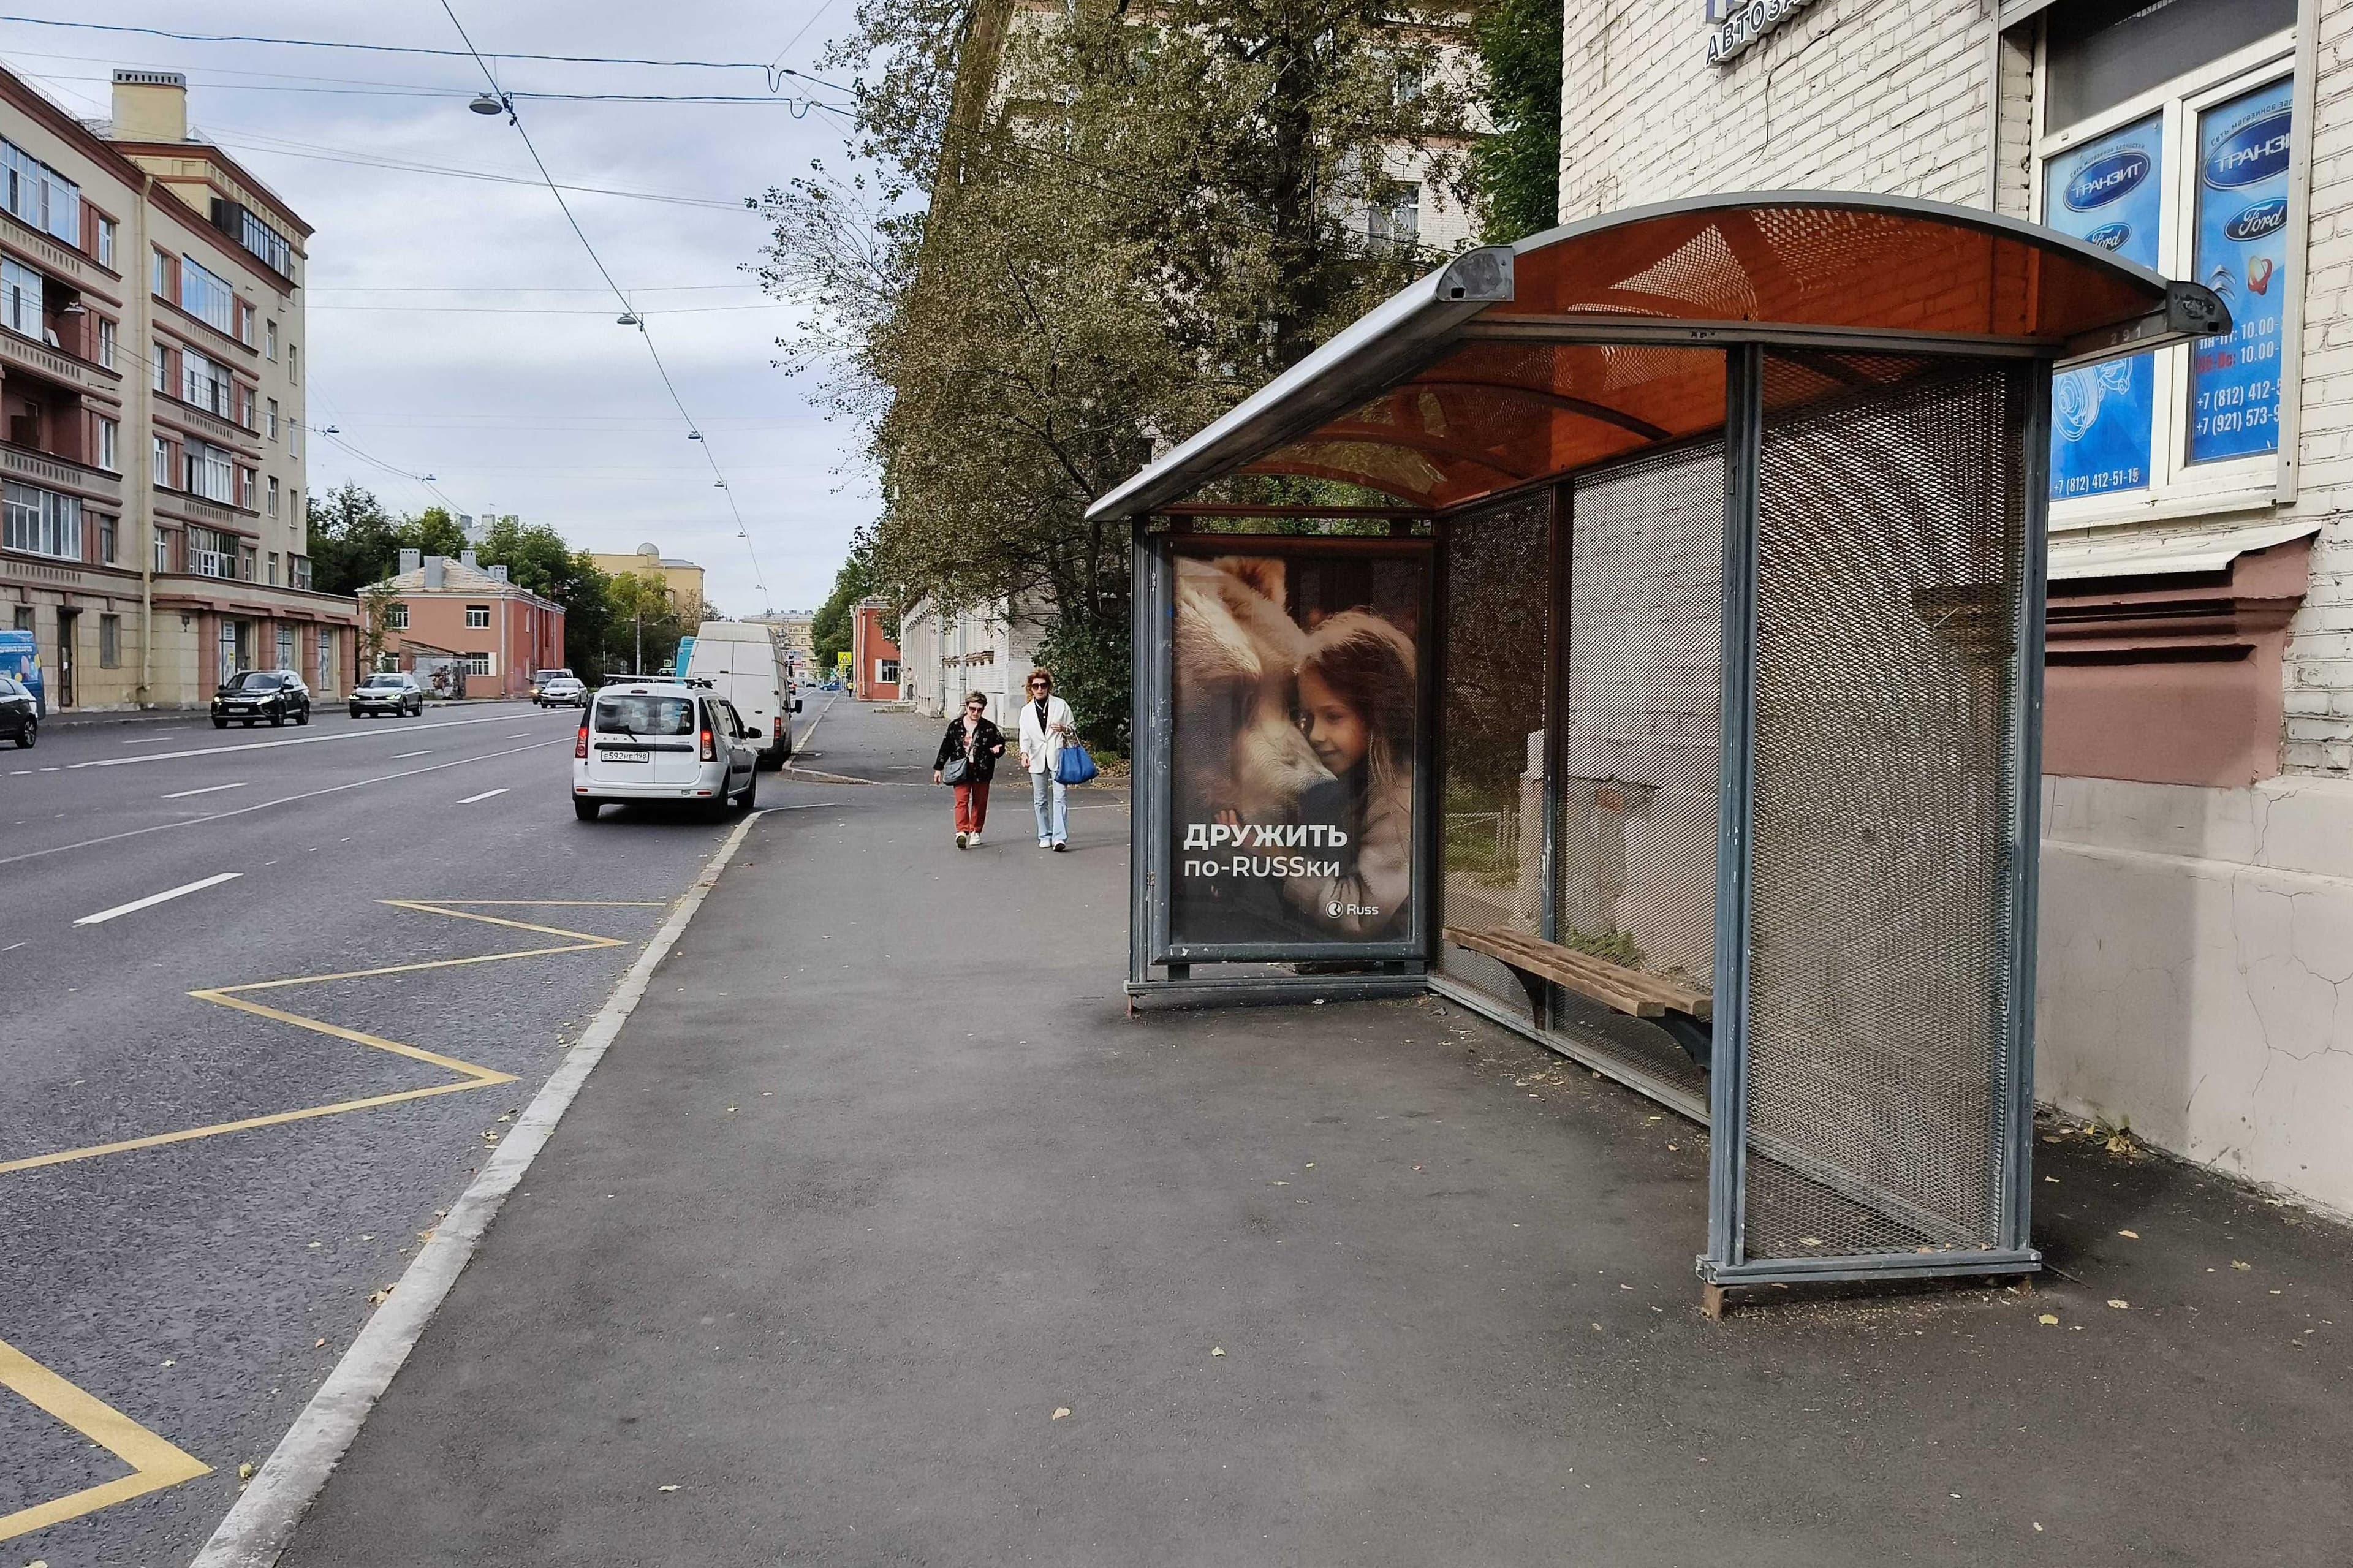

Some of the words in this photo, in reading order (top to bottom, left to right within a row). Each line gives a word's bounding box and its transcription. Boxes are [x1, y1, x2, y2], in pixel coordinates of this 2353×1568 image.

[2211, 129, 2229, 146] Сеть
[2232, 104, 2276, 129] магазинов
[2071, 161, 2142, 198] ТРАНЗИТ
[2238, 203, 2284, 236] Ford
[2197, 392, 2210, 410] +7
[2213, 385, 2244, 411] (812)
[2196, 417, 2209, 435] +7
[2212, 411, 2243, 436] (921)
[2053, 479, 2063, 494] +7
[2066, 475, 2090, 496] (812)
[1183, 823, 1348, 851] ДРУЖИТЬ
[1184, 855, 1340, 878] по-RUSSки
[1347, 903, 1379, 915] Russ
